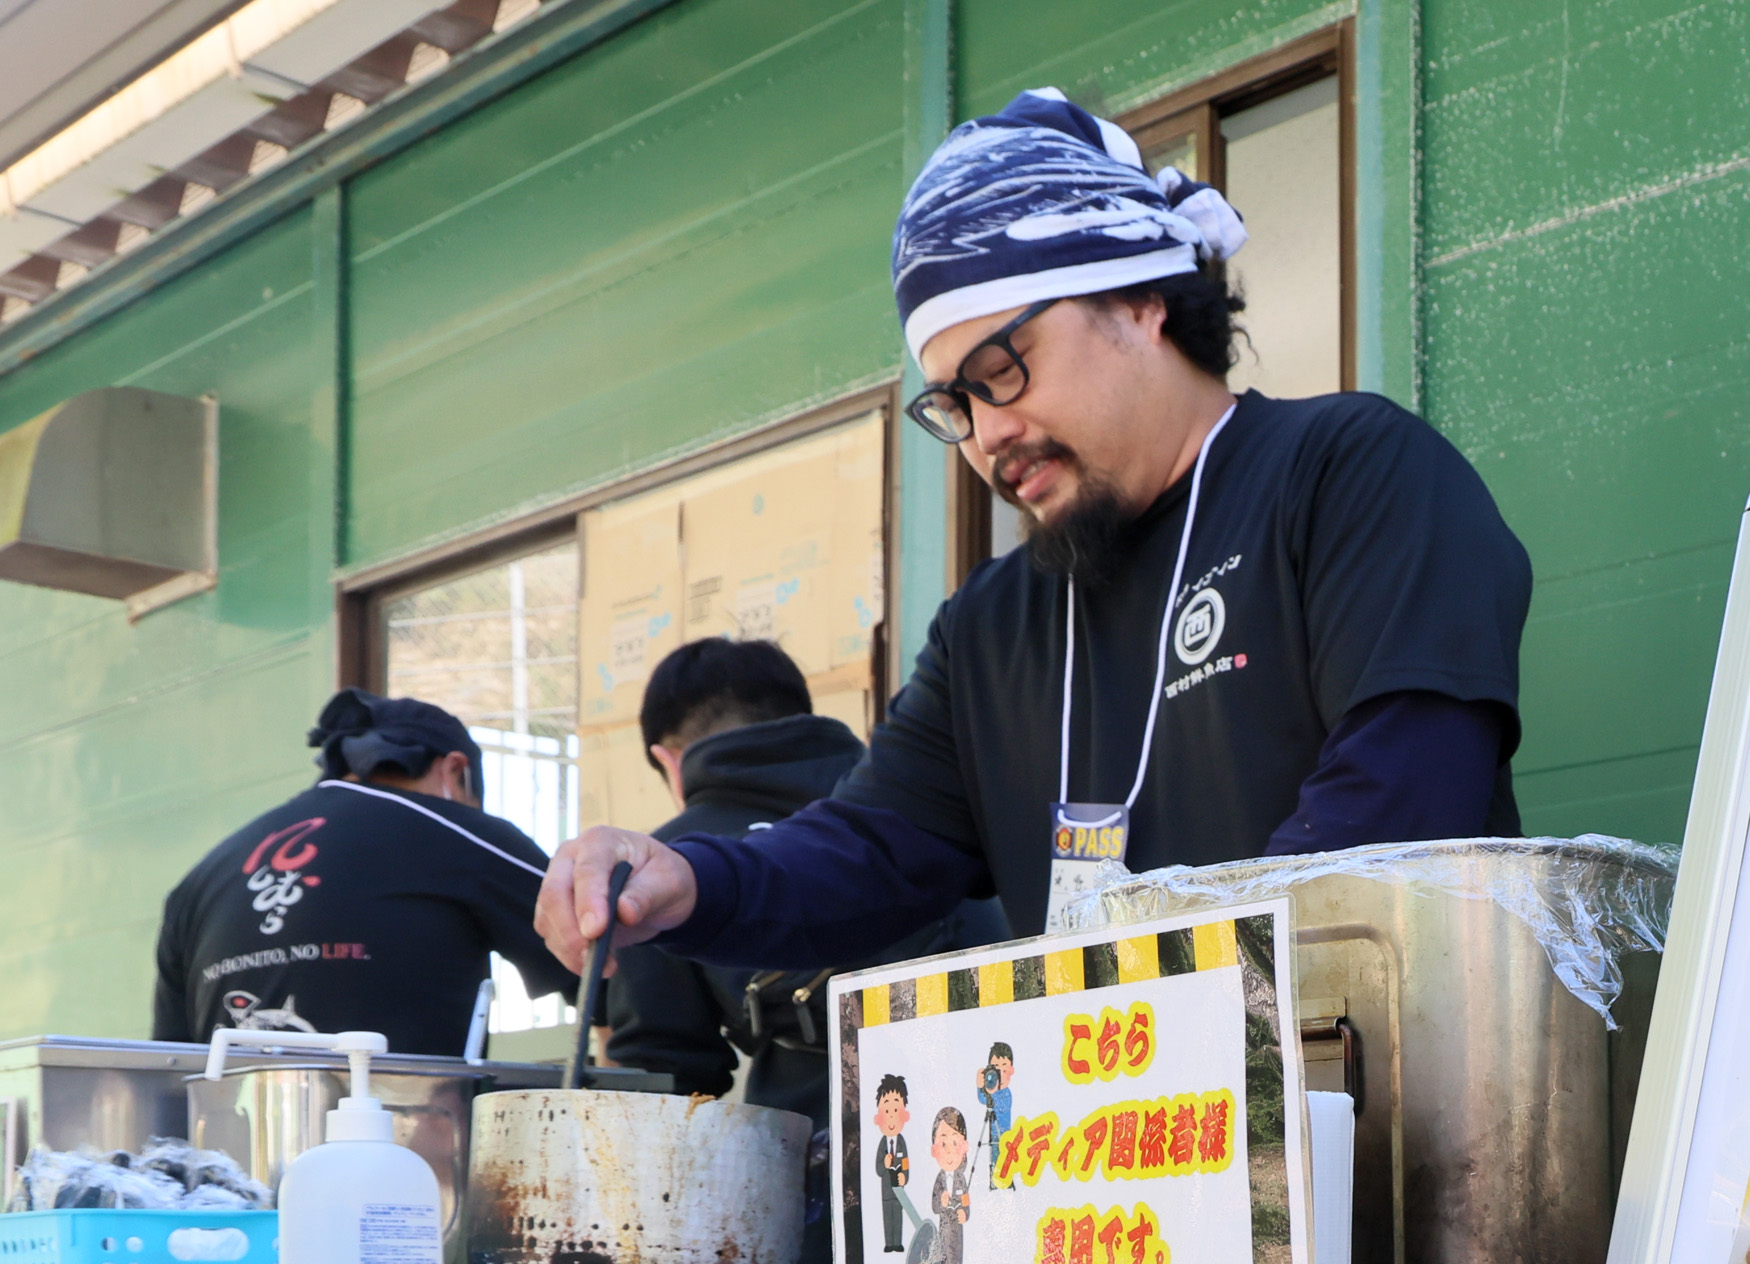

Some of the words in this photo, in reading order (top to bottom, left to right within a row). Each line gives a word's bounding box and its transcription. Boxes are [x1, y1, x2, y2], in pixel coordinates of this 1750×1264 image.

[1074, 826, 1125, 859] PASS
[290, 943, 321, 962] NO
[1066, 1010, 1151, 1075] こちら
[999, 1096, 1230, 1180] メディア関係者様
